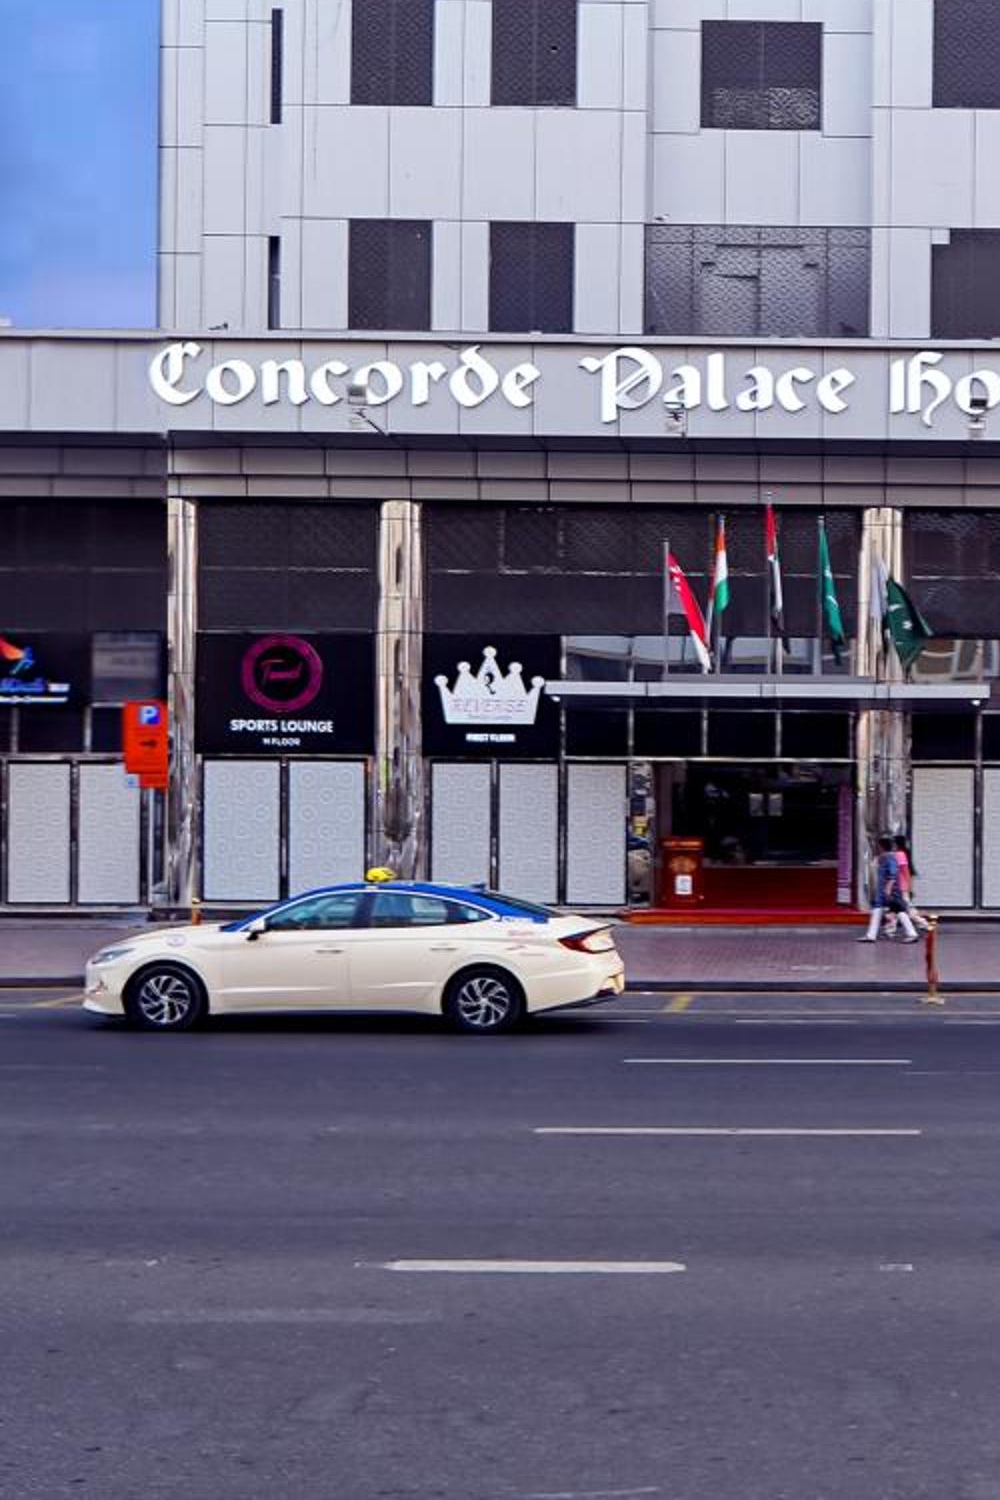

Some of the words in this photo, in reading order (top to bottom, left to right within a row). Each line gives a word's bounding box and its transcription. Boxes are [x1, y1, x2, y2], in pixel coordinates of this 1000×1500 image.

[149, 341, 541, 407] Concorde
[579, 347, 855, 424] Palace
[230, 719, 278, 732] SPORTS
[281, 720, 334, 733] LOUNGE
